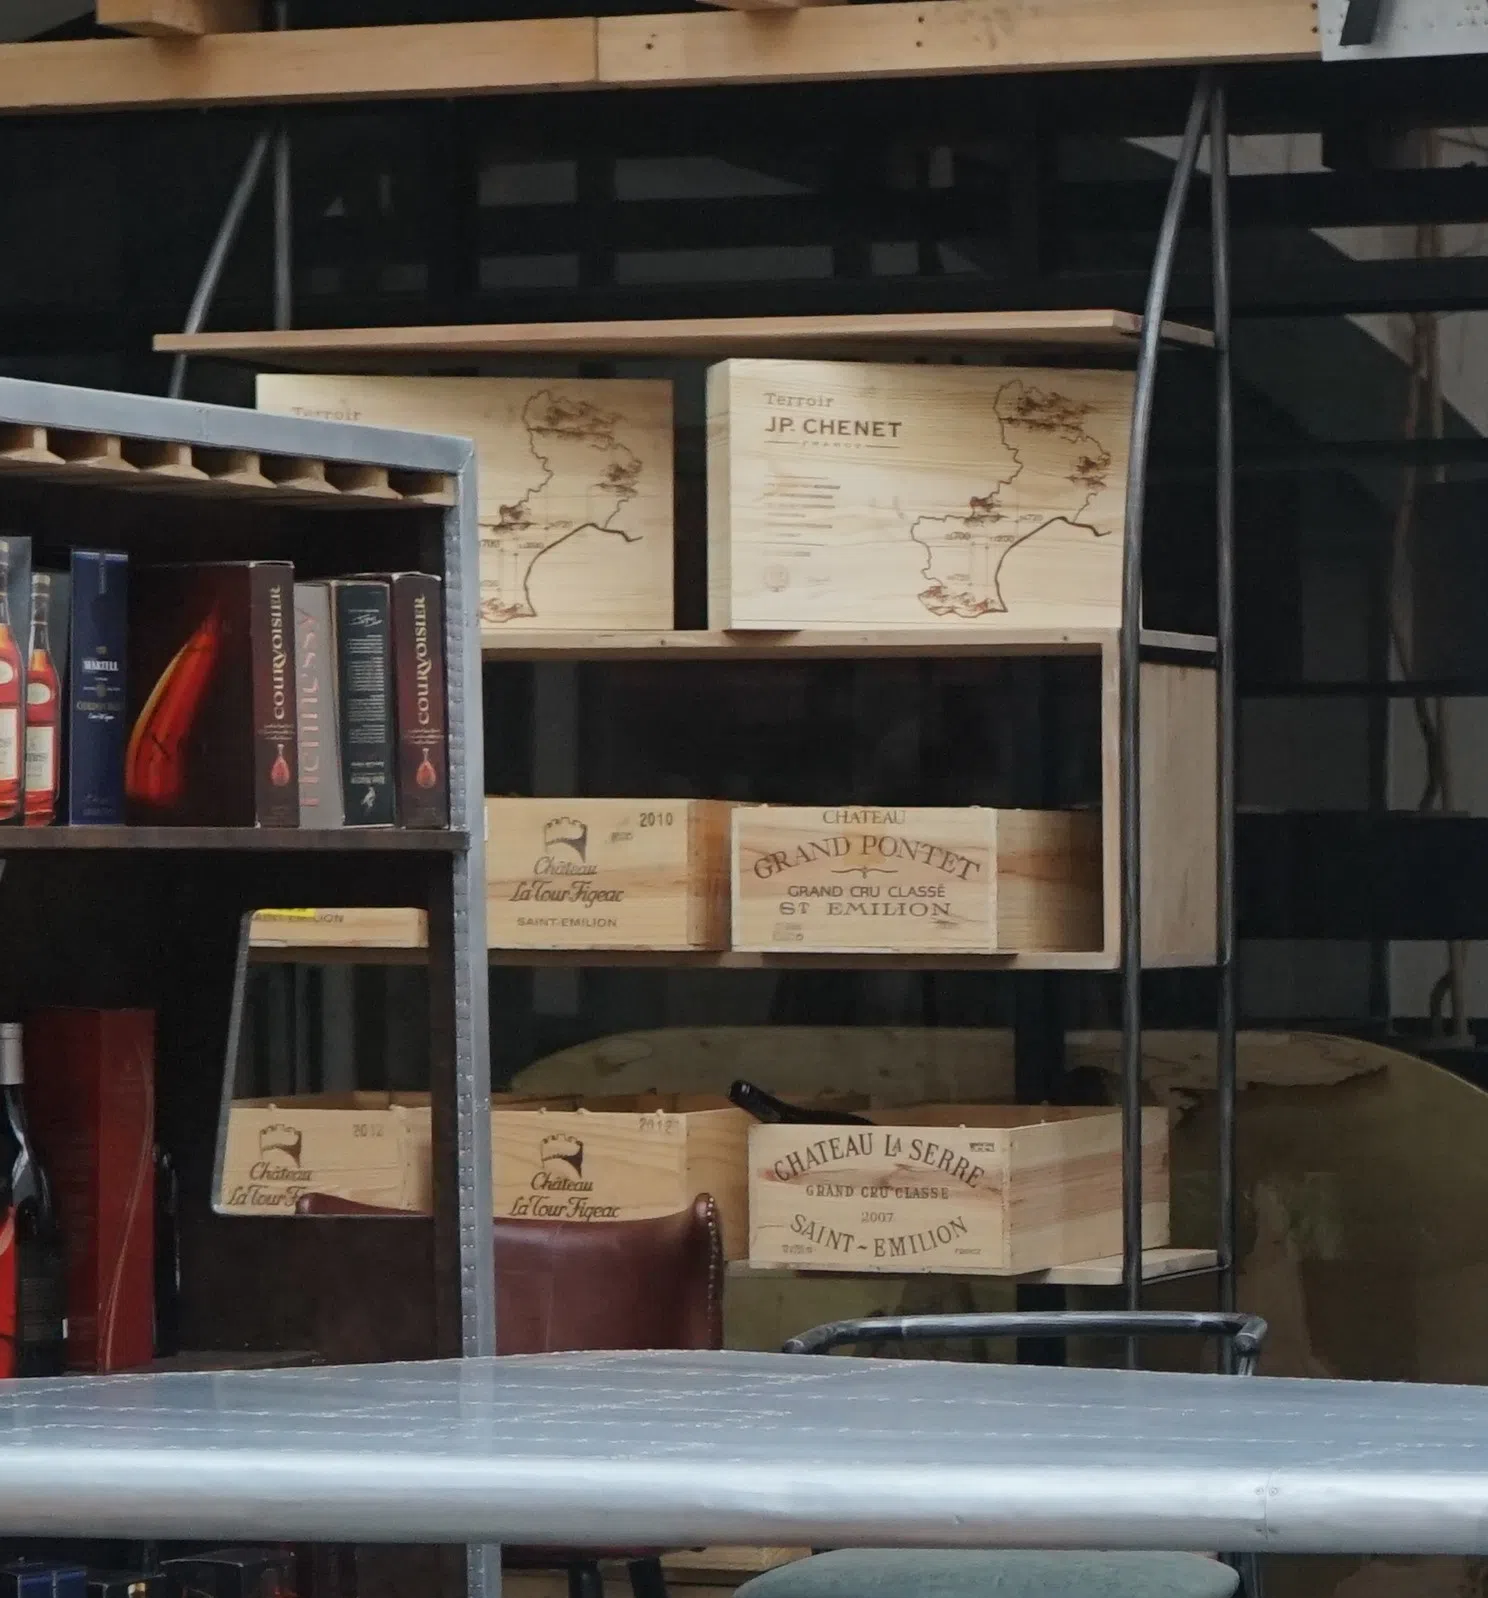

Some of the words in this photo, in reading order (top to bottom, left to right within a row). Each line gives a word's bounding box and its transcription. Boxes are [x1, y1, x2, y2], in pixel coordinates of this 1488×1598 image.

[763, 392, 834, 408] Terroir
[803, 418, 903, 438] CHENET
[269, 585, 288, 720] COURVOISIER
[414, 593, 432, 725] COURVOISIER
[639, 811, 674, 828] 2010
[822, 810, 906, 825] CHATEAU
[533, 855, 598, 876] Château
[753, 835, 852, 880] GRAND
[861, 834, 981, 881] PONTET
[508, 880, 532, 902] La
[529, 880, 571, 902] Tour
[569, 880, 625, 909] Figeac
[787, 885, 843, 898] GRAND
[850, 885, 880, 898] CRU
[888, 882, 947, 898] CLASSÉ
[826, 902, 952, 917] EMILION
[248, 1160, 314, 1182] Château
[773, 1132, 875, 1182] CHATEAU
[908, 1138, 986, 1190] SERRE
[530, 1171, 595, 1192] Château
[227, 1185, 249, 1206] La
[247, 1184, 286, 1206] Tour
[805, 1186, 855, 1198] GRAND
[860, 1187, 889, 1199] CRU
[894, 1187, 949, 1200] CLASSE
[508, 1195, 530, 1217] La
[527, 1195, 568, 1217] Tour
[566, 1196, 623, 1222] Figeac
[860, 1211, 895, 1224] 2007
